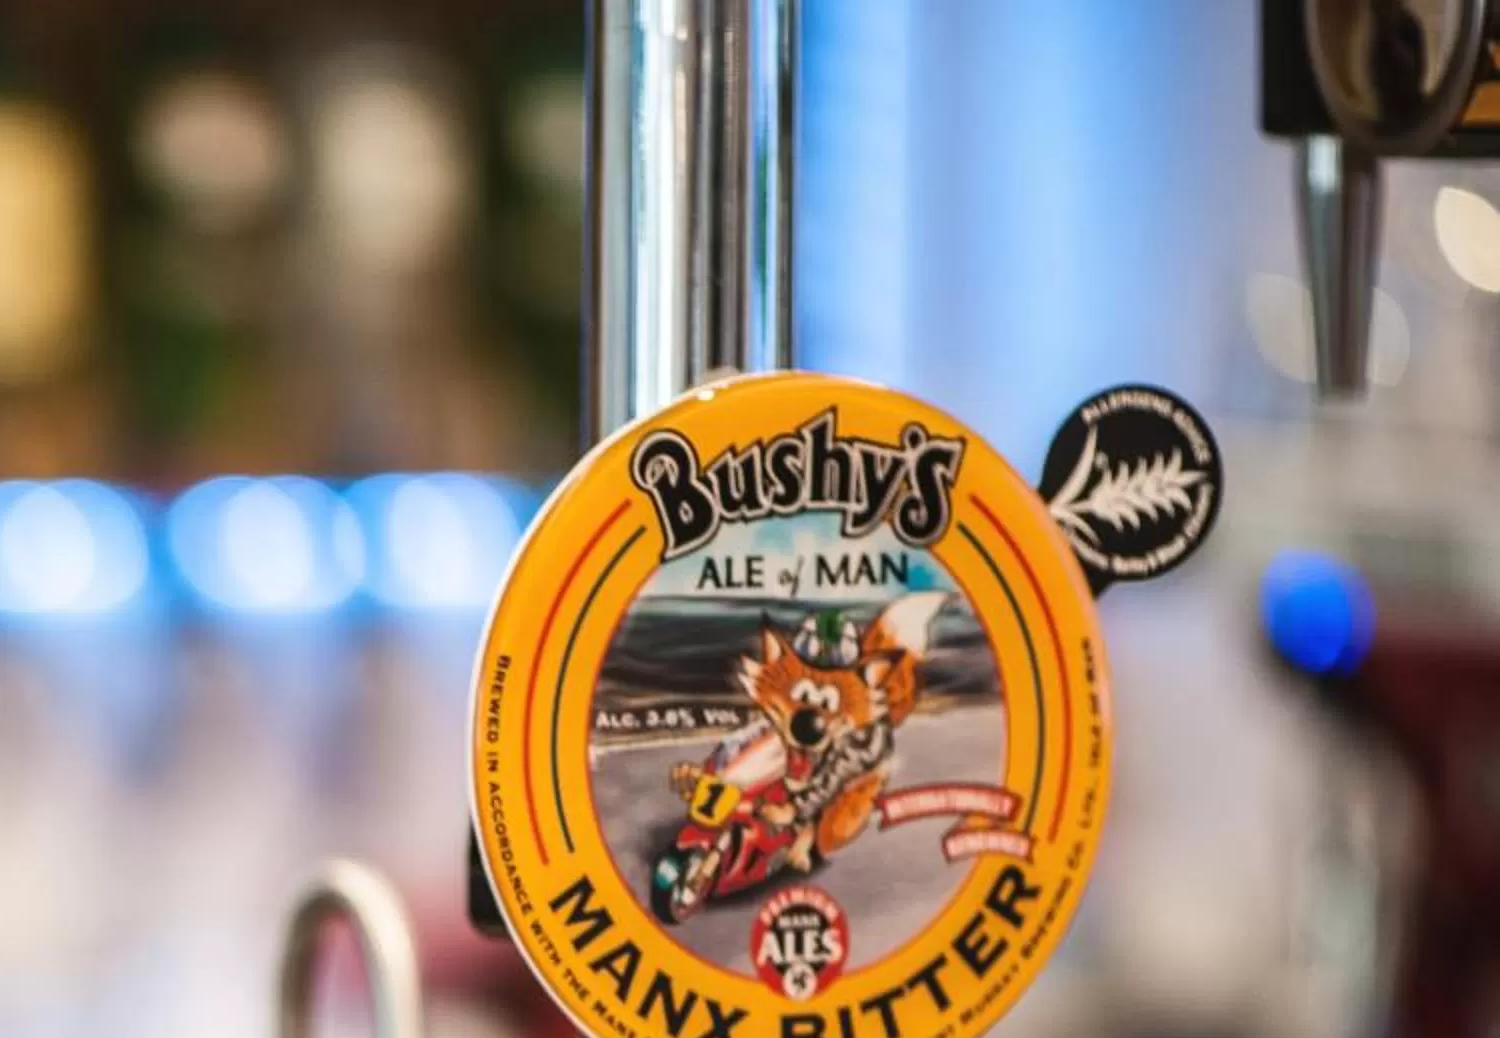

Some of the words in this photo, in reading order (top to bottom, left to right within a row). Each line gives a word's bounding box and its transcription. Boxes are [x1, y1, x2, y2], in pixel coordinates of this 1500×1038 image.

[630, 401, 967, 564] Bushy's
[697, 554, 764, 590] ALE
[778, 555, 803, 595] of
[816, 553, 909, 586] MAN
[486, 655, 512, 743] BREWED
[486, 751, 499, 773] IN
[698, 783, 726, 819] 1
[488, 781, 533, 915] ACCORDANCE
[530, 918, 562, 967] WITH
[756, 929, 844, 968] ALES
